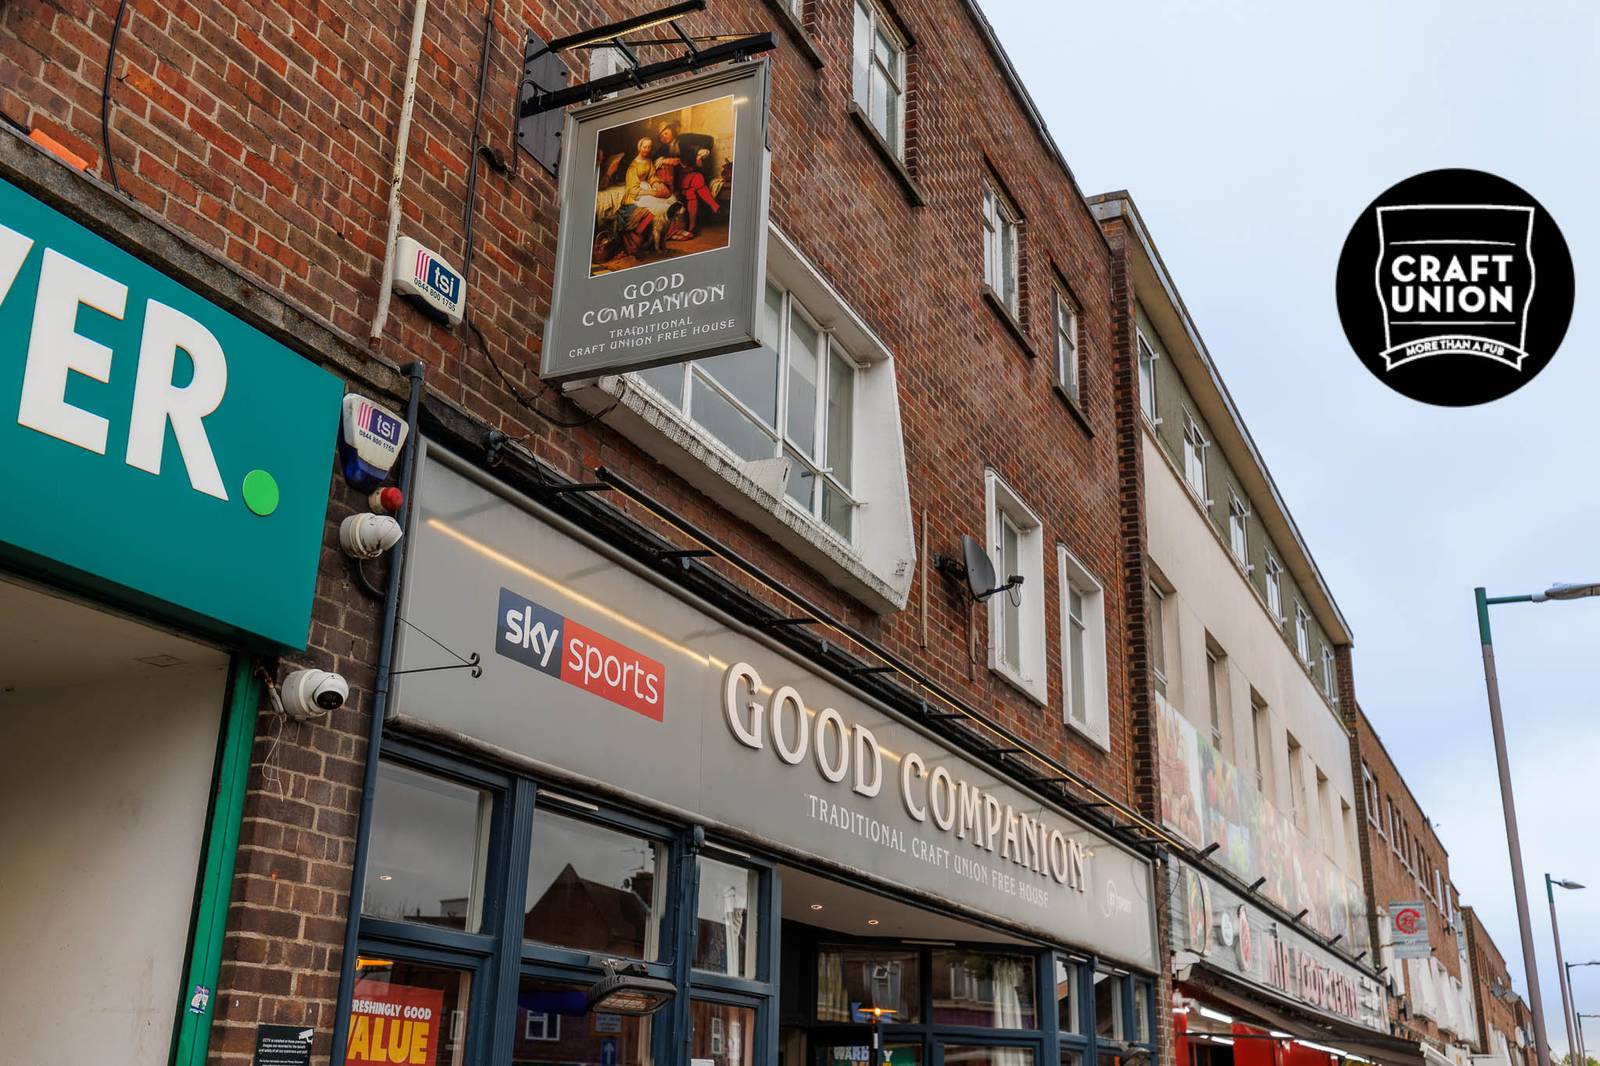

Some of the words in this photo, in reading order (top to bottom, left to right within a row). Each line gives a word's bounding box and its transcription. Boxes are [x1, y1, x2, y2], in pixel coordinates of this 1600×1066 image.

[414, 278, 429, 293] 0844
[429, 288, 441, 301] 800
[434, 266, 455, 298] tsi
[623, 272, 685, 301] GOOD
[582, 284, 726, 327] COMPANION
[568, 343, 606, 359] CRAFT
[610, 335, 653, 351] UNION
[657, 329, 688, 343] FREE
[692, 318, 736, 336] HOUSE
[609, 316, 693, 339] TRADITIONAL
[377, 415, 396, 440] tsi
[505, 605, 559, 667] sky
[568, 637, 659, 705] sports
[723, 661, 883, 798] GOOD
[900, 752, 1086, 892] COMPANION
[809, 794, 906, 854] TRADITIONAL
[912, 837, 950, 869] CRAFT
[954, 854, 989, 886] UNION
[992, 869, 1017, 897] FREE
[1019, 880, 1050, 909] HOUSE
[404, 1005, 432, 1020] GOOD
